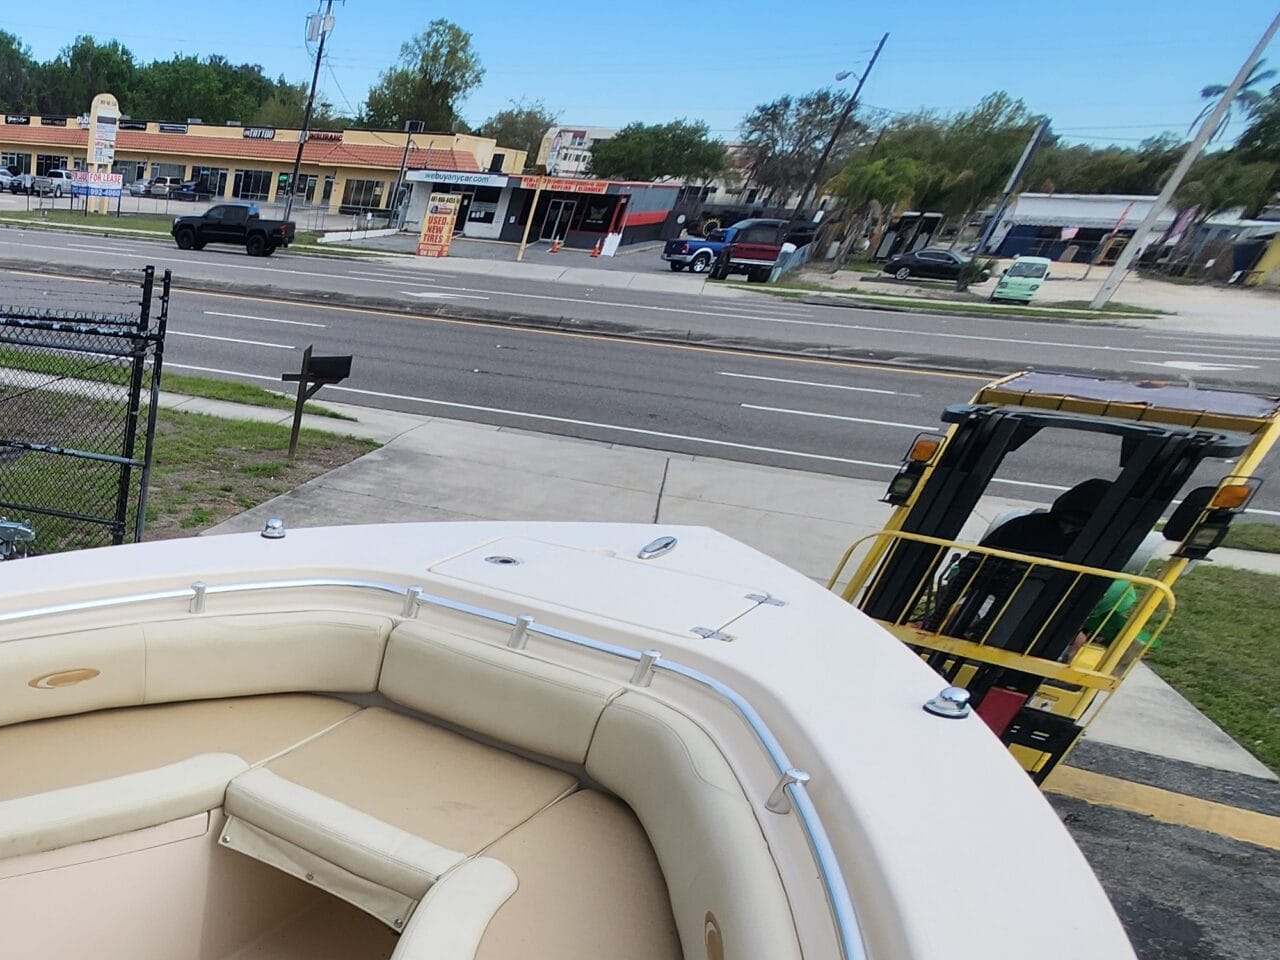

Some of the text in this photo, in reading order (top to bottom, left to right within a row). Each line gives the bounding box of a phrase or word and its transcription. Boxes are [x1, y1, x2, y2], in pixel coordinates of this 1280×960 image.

[424, 173, 489, 183] webuyanycar.com
[426, 225, 444, 234] NEW
[423, 233, 444, 243] TIRES
